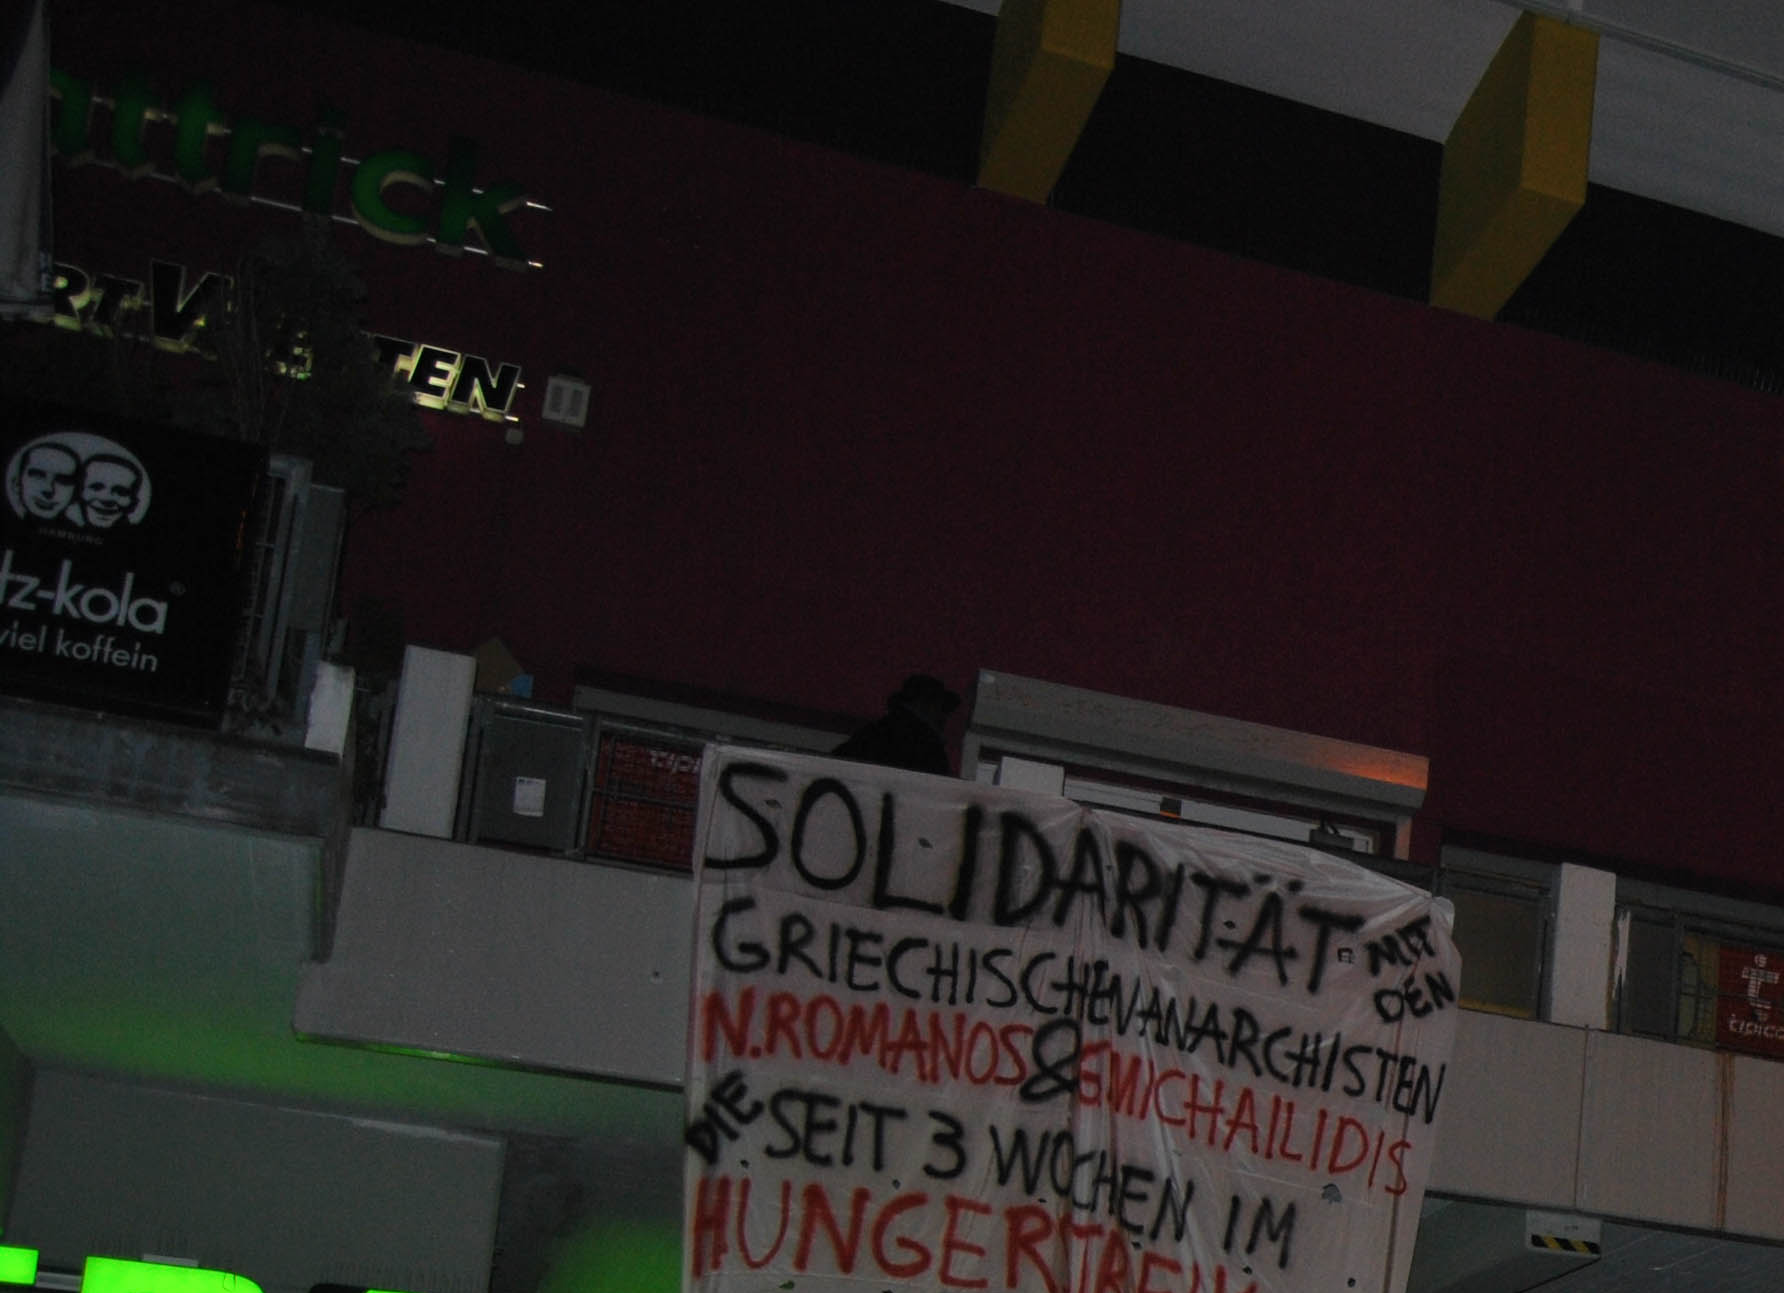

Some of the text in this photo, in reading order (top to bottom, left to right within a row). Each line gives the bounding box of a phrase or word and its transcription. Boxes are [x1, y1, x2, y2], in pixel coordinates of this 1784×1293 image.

[55, 627, 159, 673] koffein
[703, 760, 1364, 995] SOLIDARITÄT
[702, 985, 1035, 1087] N.ROMANOS
[1018, 1017, 1083, 1103] &
[1373, 970, 1456, 1024] DEN
[683, 1069, 764, 1167] DIE
[764, 1087, 909, 1172] SEIT
[922, 1110, 968, 1181] 3
[1223, 1193, 1299, 1270] IM
